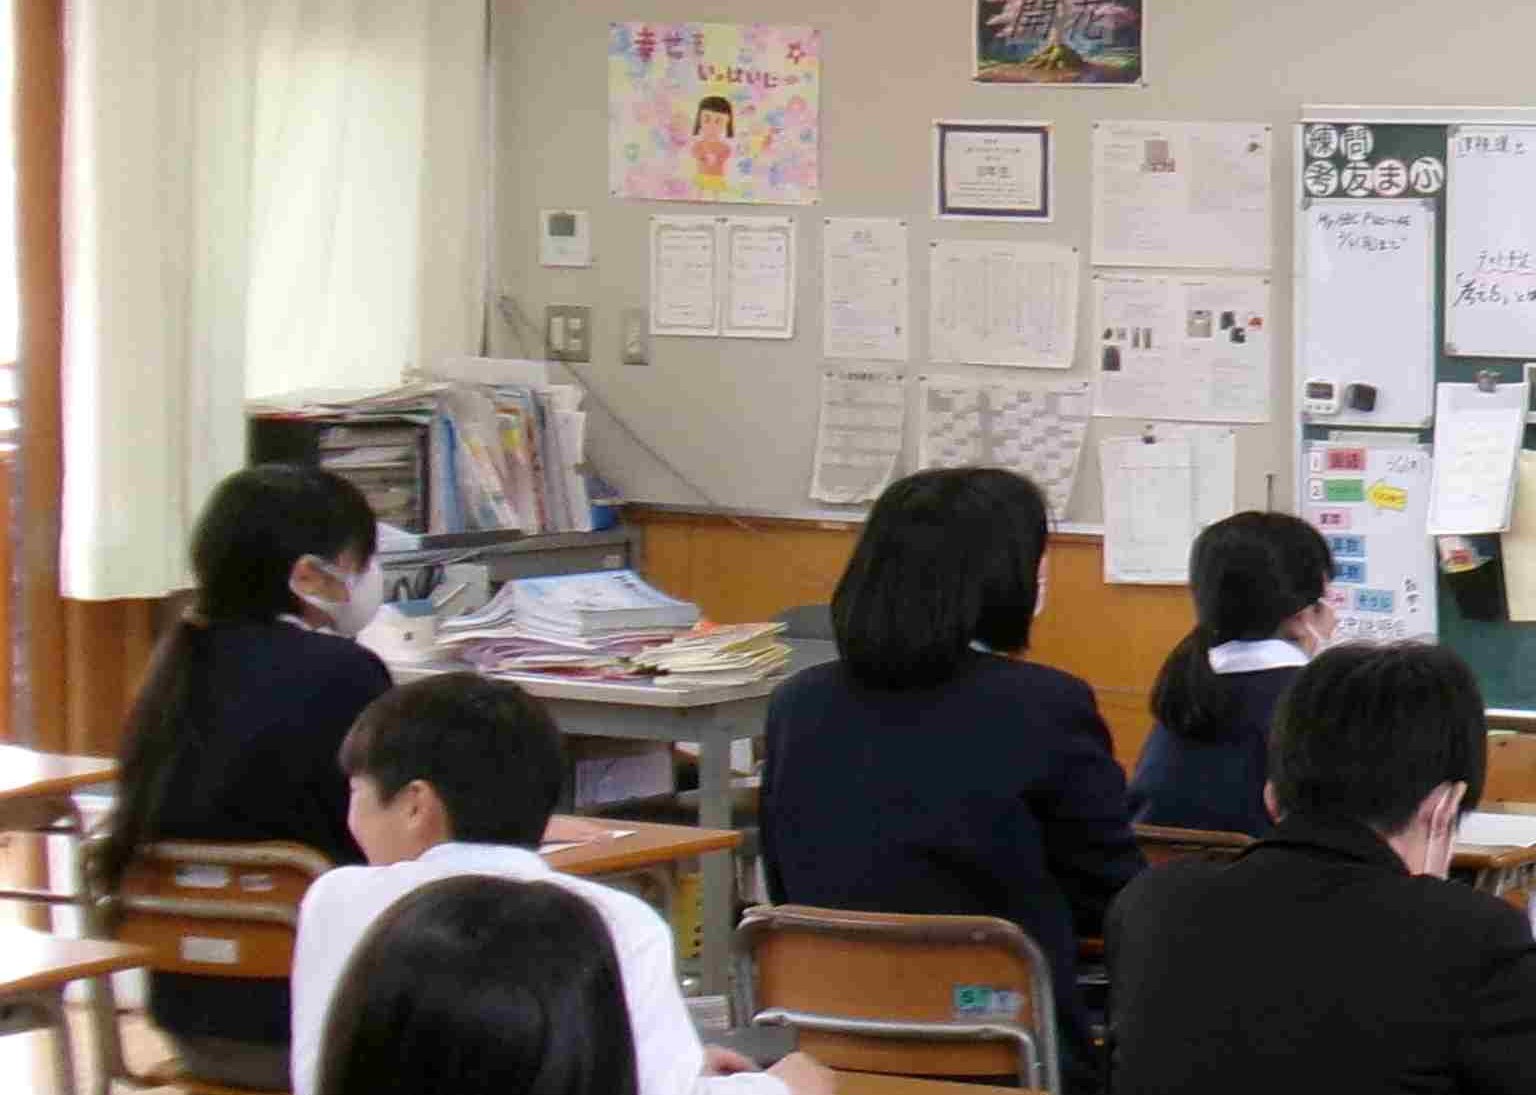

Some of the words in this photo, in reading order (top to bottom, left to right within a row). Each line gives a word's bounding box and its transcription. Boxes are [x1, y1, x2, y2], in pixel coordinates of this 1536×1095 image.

[1305, 163, 1334, 193] 考
[1378, 163, 1401, 190] ま
[1411, 159, 1442, 188] ふ
